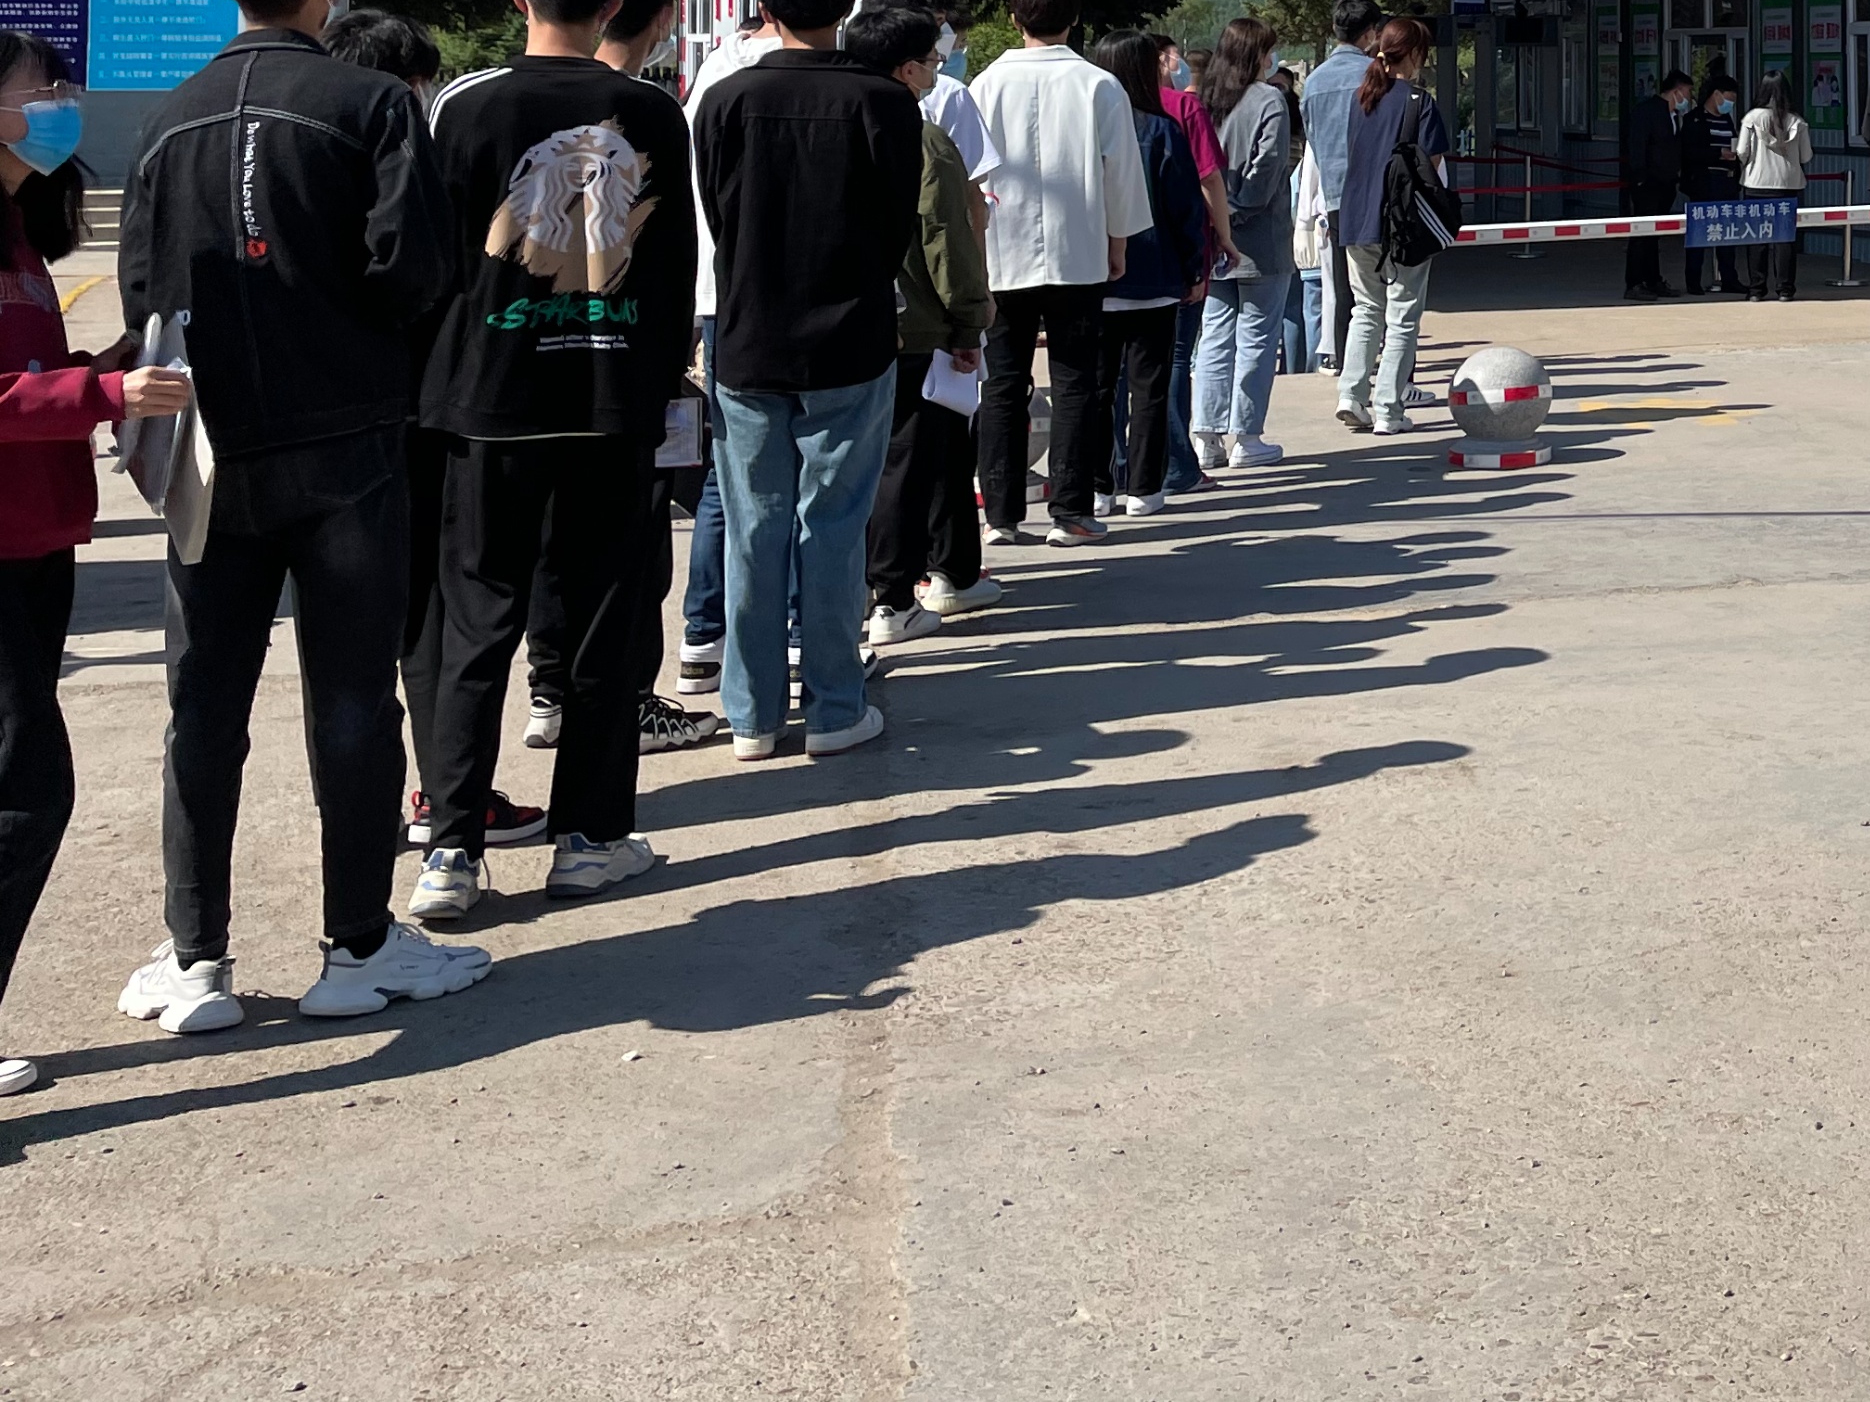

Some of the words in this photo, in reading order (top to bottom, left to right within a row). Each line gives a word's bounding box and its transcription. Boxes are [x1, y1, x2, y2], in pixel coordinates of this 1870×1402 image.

[1691, 201, 1791, 220] 机动车非机动车
[1706, 220, 1774, 242] 禁止入内
